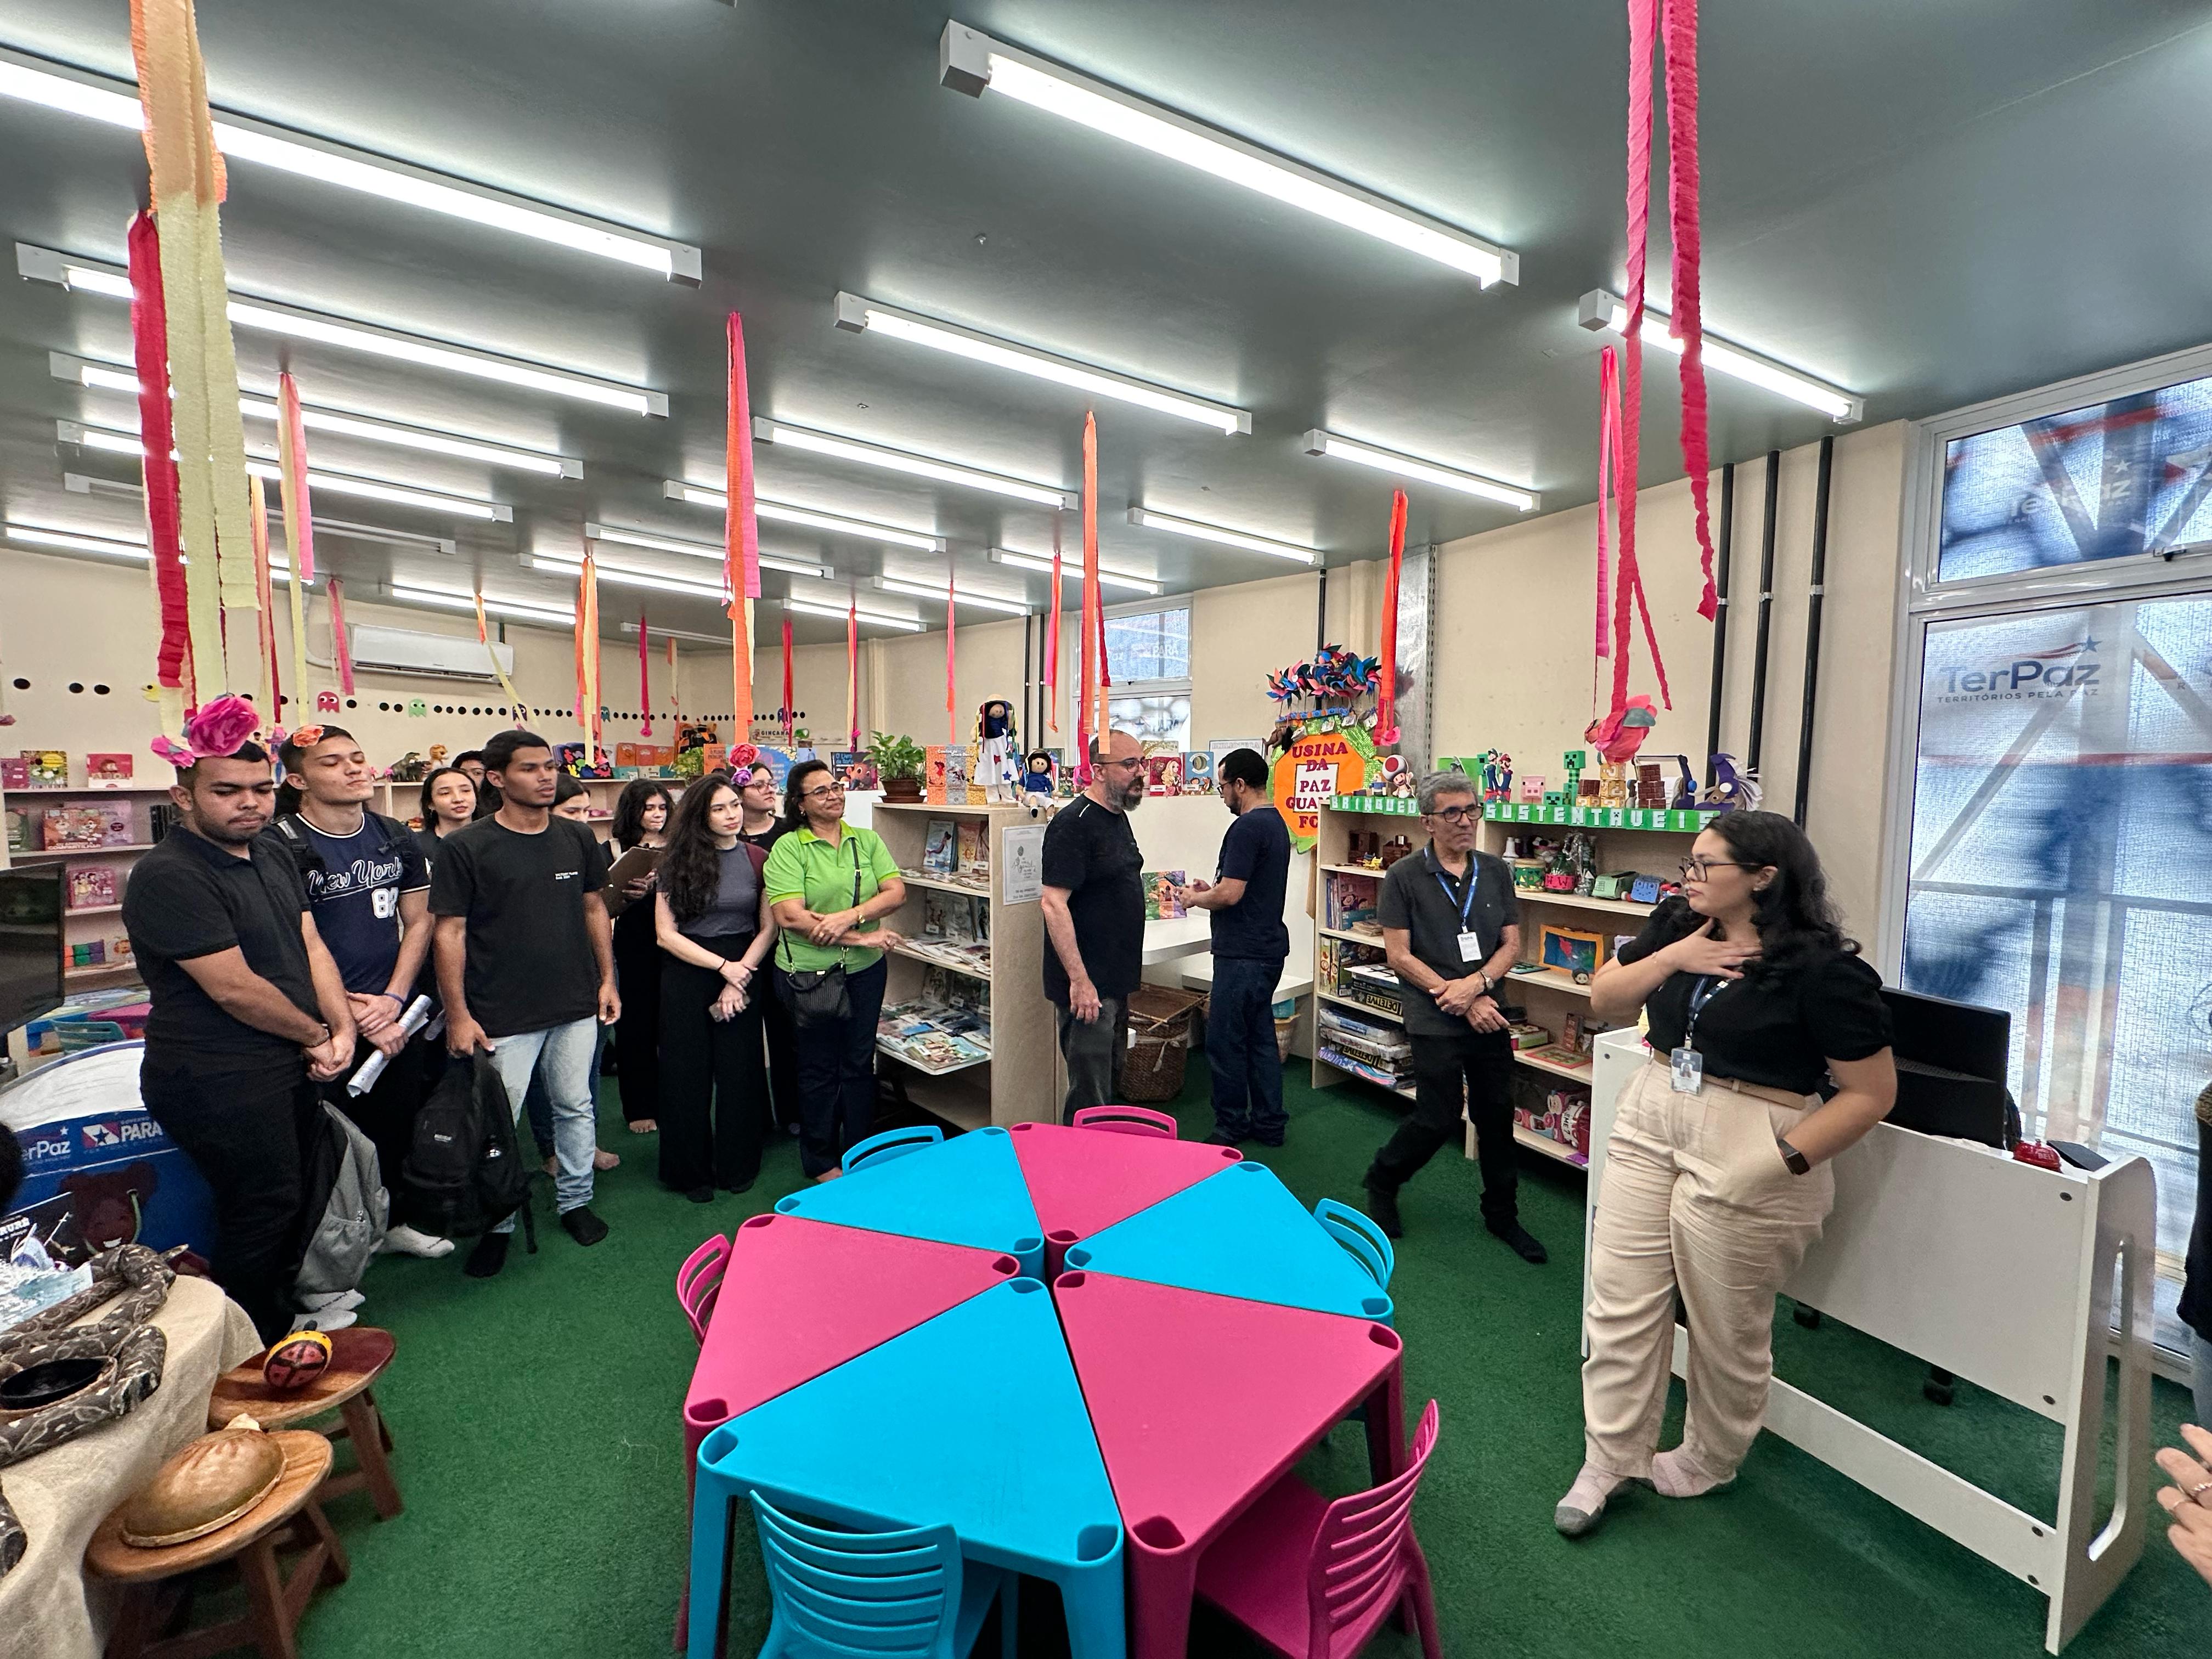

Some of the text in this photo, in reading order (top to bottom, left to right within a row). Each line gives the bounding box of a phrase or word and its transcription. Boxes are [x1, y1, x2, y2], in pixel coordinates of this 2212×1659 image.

[1939, 660, 2101, 693] TerPaz
[1937, 692, 2022, 703] TERRITÓRIOS
[2028, 690, 2063, 698] PELA
[1292, 742, 1348, 758] USINA
[1306, 758, 1329, 772] DA
[1300, 779, 1331, 792] PAZ
[1285, 797, 1330, 810] GUA
[307, 856, 403, 895] New York
[1367, 995, 1398, 1013] DETETIVE
[21, 1140, 71, 1160] erPaz
